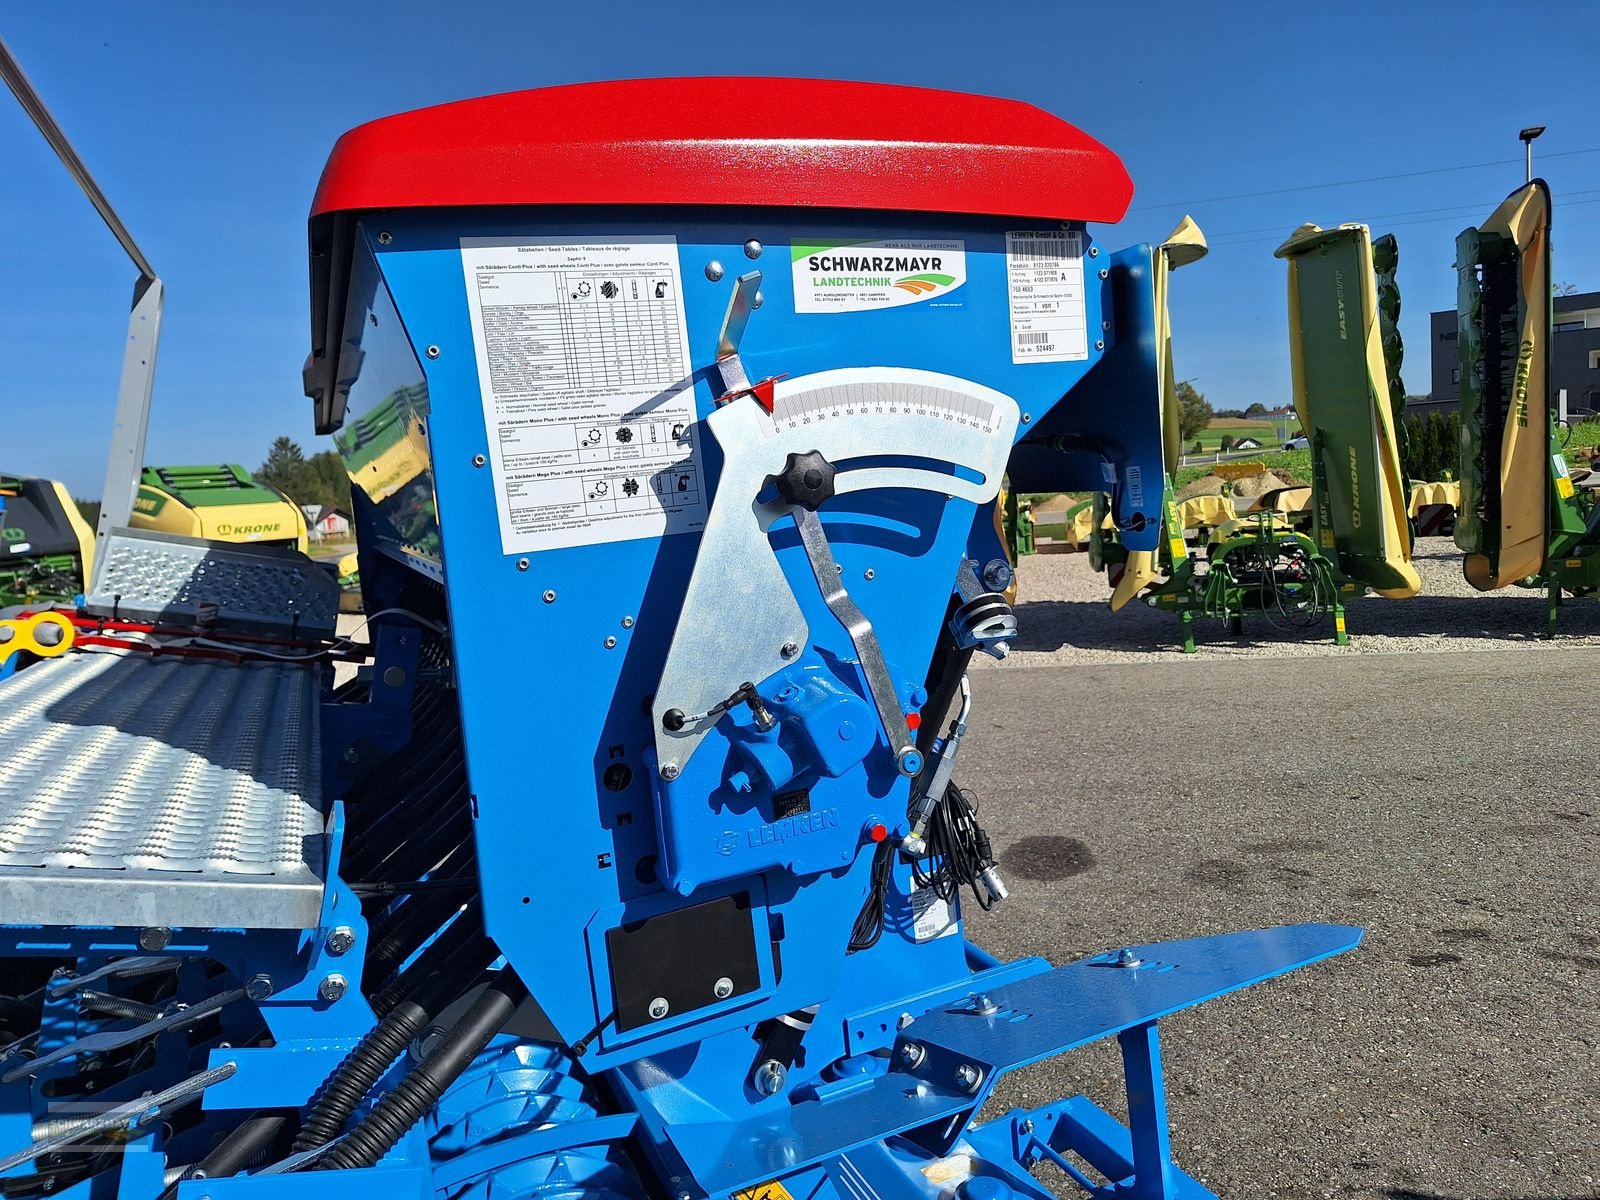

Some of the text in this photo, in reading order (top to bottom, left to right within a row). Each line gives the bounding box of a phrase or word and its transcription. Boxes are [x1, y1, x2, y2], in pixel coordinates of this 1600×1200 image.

[809, 257, 942, 271] SCHWARZMAYR
[813, 277, 892, 287] LANDTECHNIK
[1061, 273, 1066, 281] A
[1516, 363, 1529, 428] KRONE
[956, 416, 967, 425] 130
[969, 421, 980, 429] 140
[982, 425, 992, 434] 150
[1349, 446, 1360, 508] KRONE
[234, 524, 281, 534] KRONE
[746, 808, 838, 848] LEMKEN
